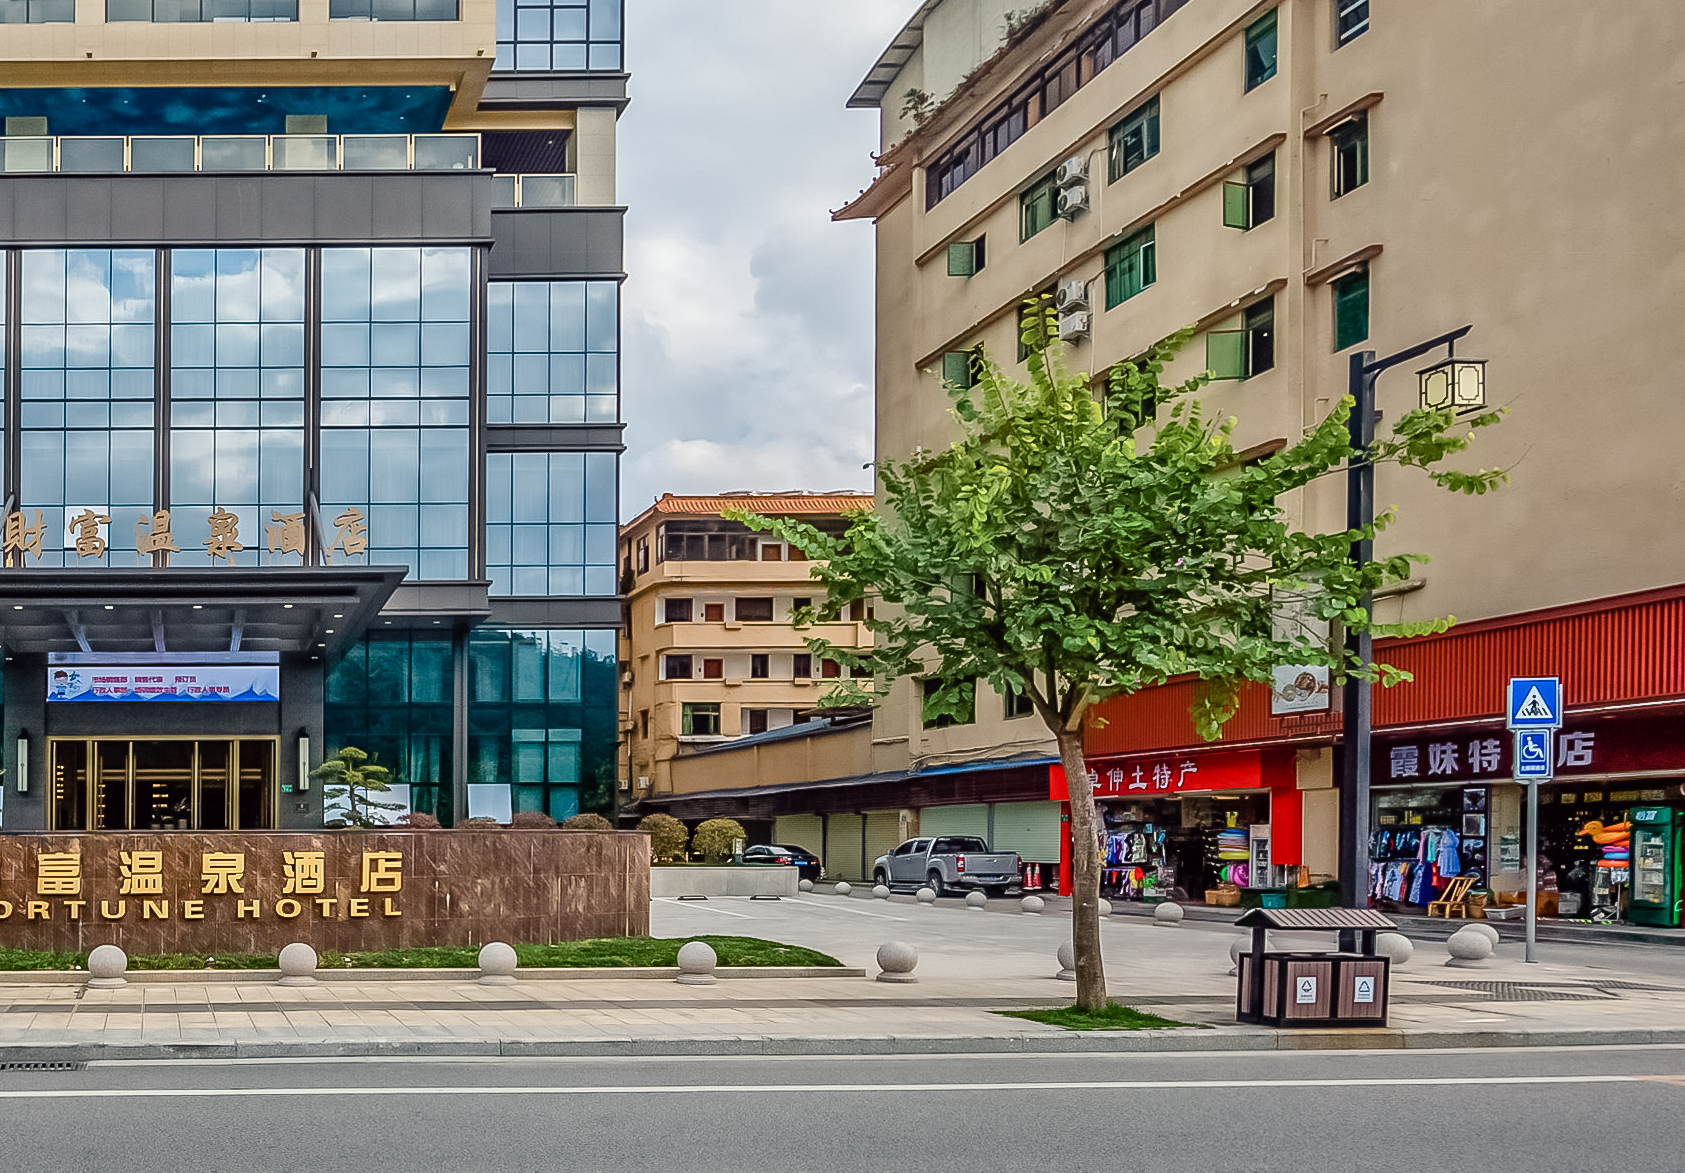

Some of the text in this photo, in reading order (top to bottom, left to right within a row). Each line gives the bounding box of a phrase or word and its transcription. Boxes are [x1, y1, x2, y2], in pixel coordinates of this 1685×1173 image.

[1390, 731, 1595, 778] 霞妹特店
[237, 898, 403, 919] HOTEL
